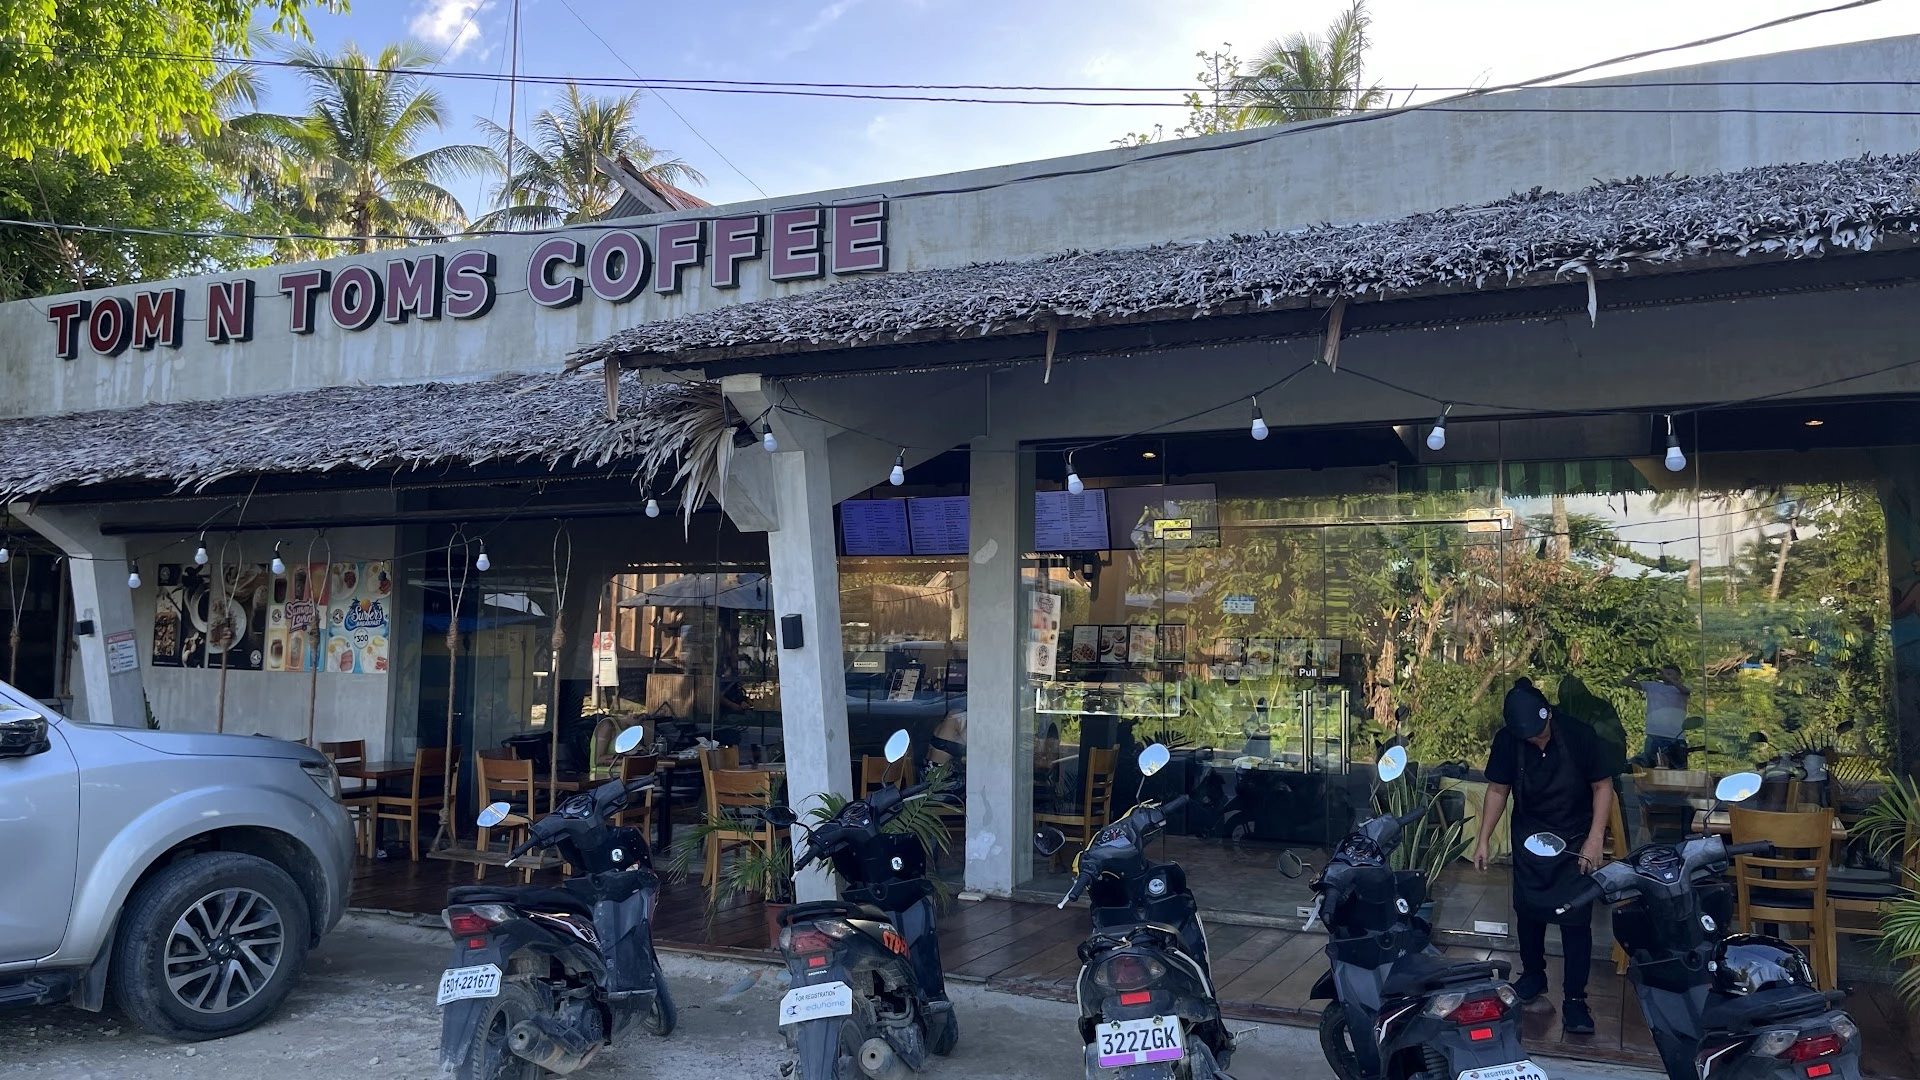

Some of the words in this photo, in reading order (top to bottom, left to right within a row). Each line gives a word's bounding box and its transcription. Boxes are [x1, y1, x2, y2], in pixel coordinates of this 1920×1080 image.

[47, 288, 185, 360] TOM
[206, 279, 254, 343] N
[278, 250, 496, 334] TOMS
[526, 194, 889, 308] COFFEE
[1299, 668, 1317, 677] Pull
[443, 974, 495, 994] 1501-221677
[805, 991, 836, 1000] REGISTRATION
[806, 999, 845, 1011] eduhome
[1102, 1026, 1177, 1055] 322ZGK
[1484, 1069, 1514, 1078] REGISTERED
